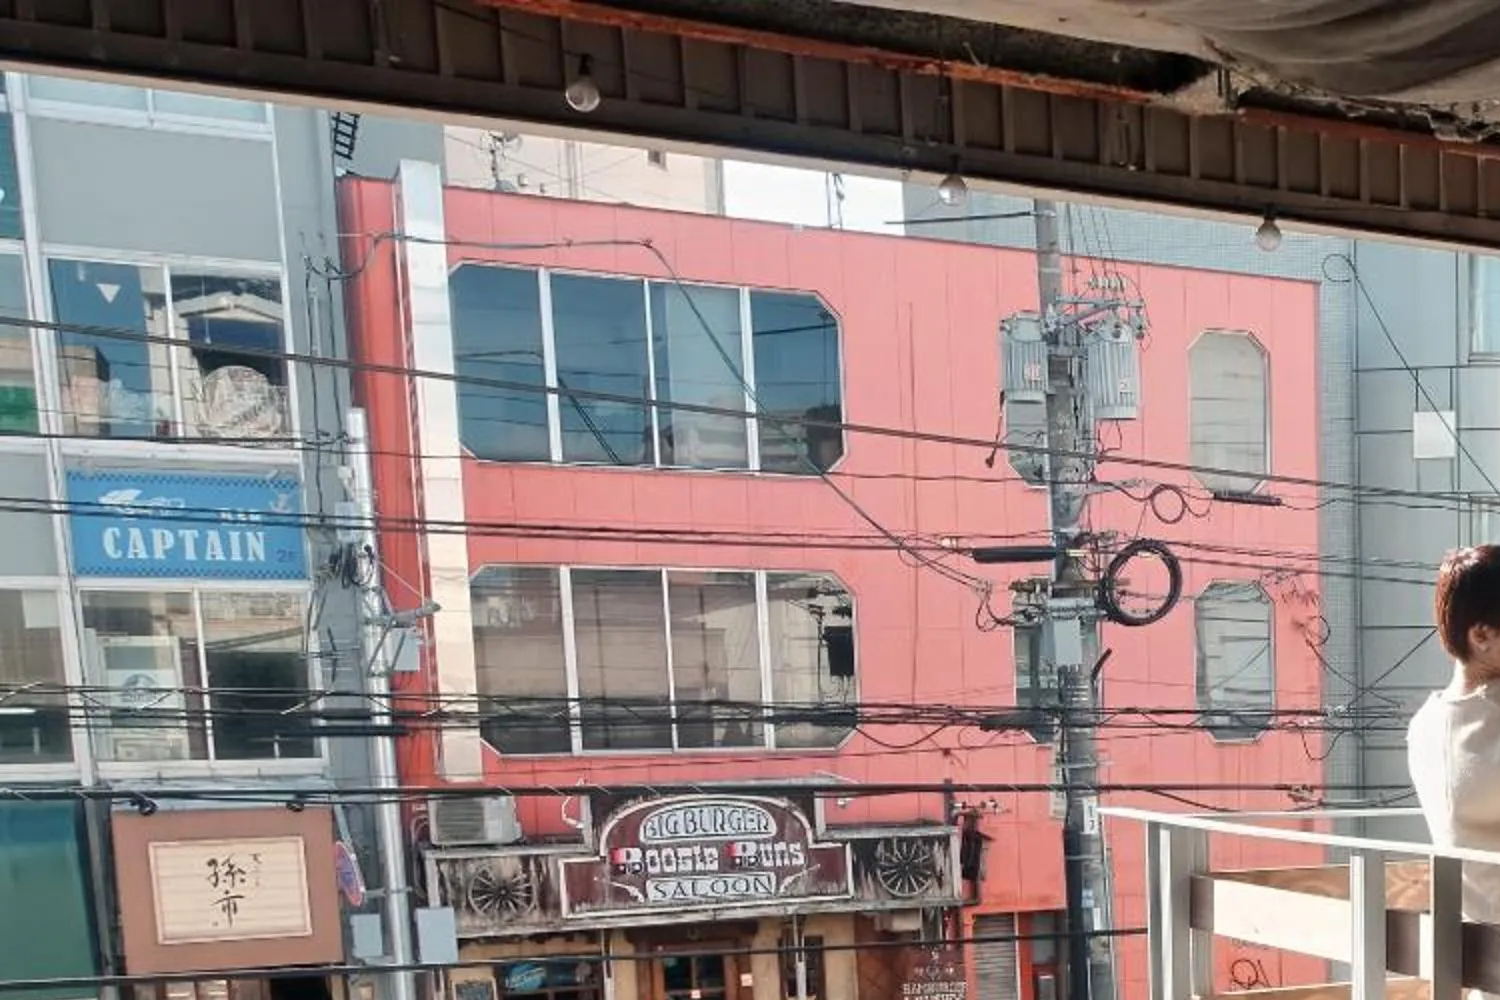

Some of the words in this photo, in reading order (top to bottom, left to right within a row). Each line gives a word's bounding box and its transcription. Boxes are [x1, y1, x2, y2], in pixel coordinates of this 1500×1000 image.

[103, 526, 267, 562] CAPTAIN
[644, 811, 678, 837] BIG
[683, 808, 769, 834] BURGER
[652, 876, 774, 900] SALOON
